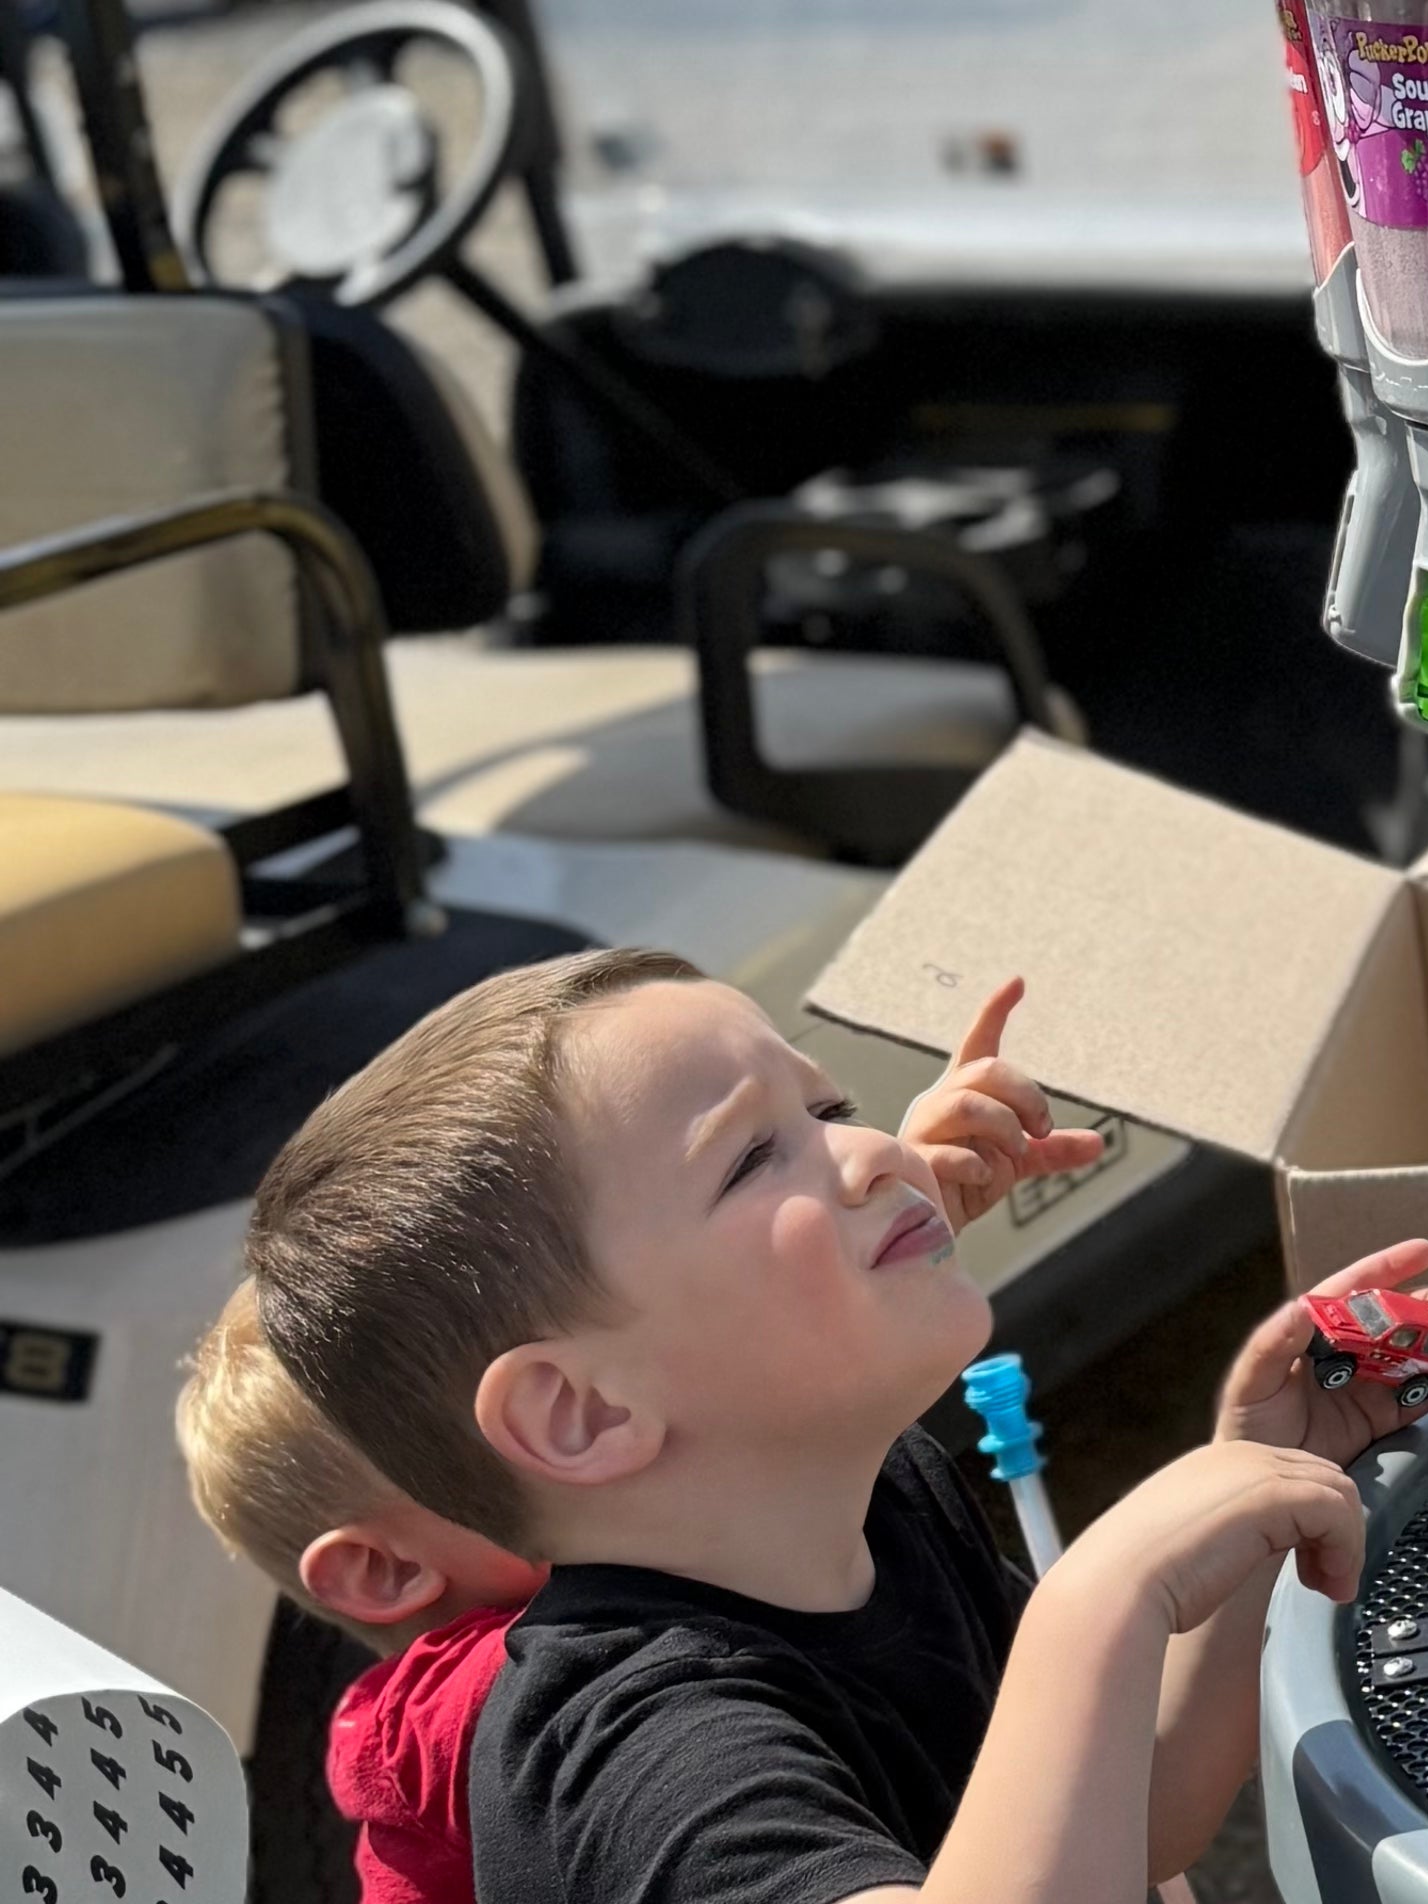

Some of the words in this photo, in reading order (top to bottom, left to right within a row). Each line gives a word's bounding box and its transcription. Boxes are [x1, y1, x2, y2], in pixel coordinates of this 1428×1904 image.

[81, 1696, 123, 1739] 5
[26, 1756, 62, 1801] 4
[90, 1747, 127, 1791] 4
[152, 1739, 194, 1783] 5
[26, 1810, 63, 1854] 3
[94, 1800, 128, 1845] 4
[158, 1791, 195, 1835] 4
[90, 1855, 126, 1899] 3
[159, 1844, 194, 1890] 4
